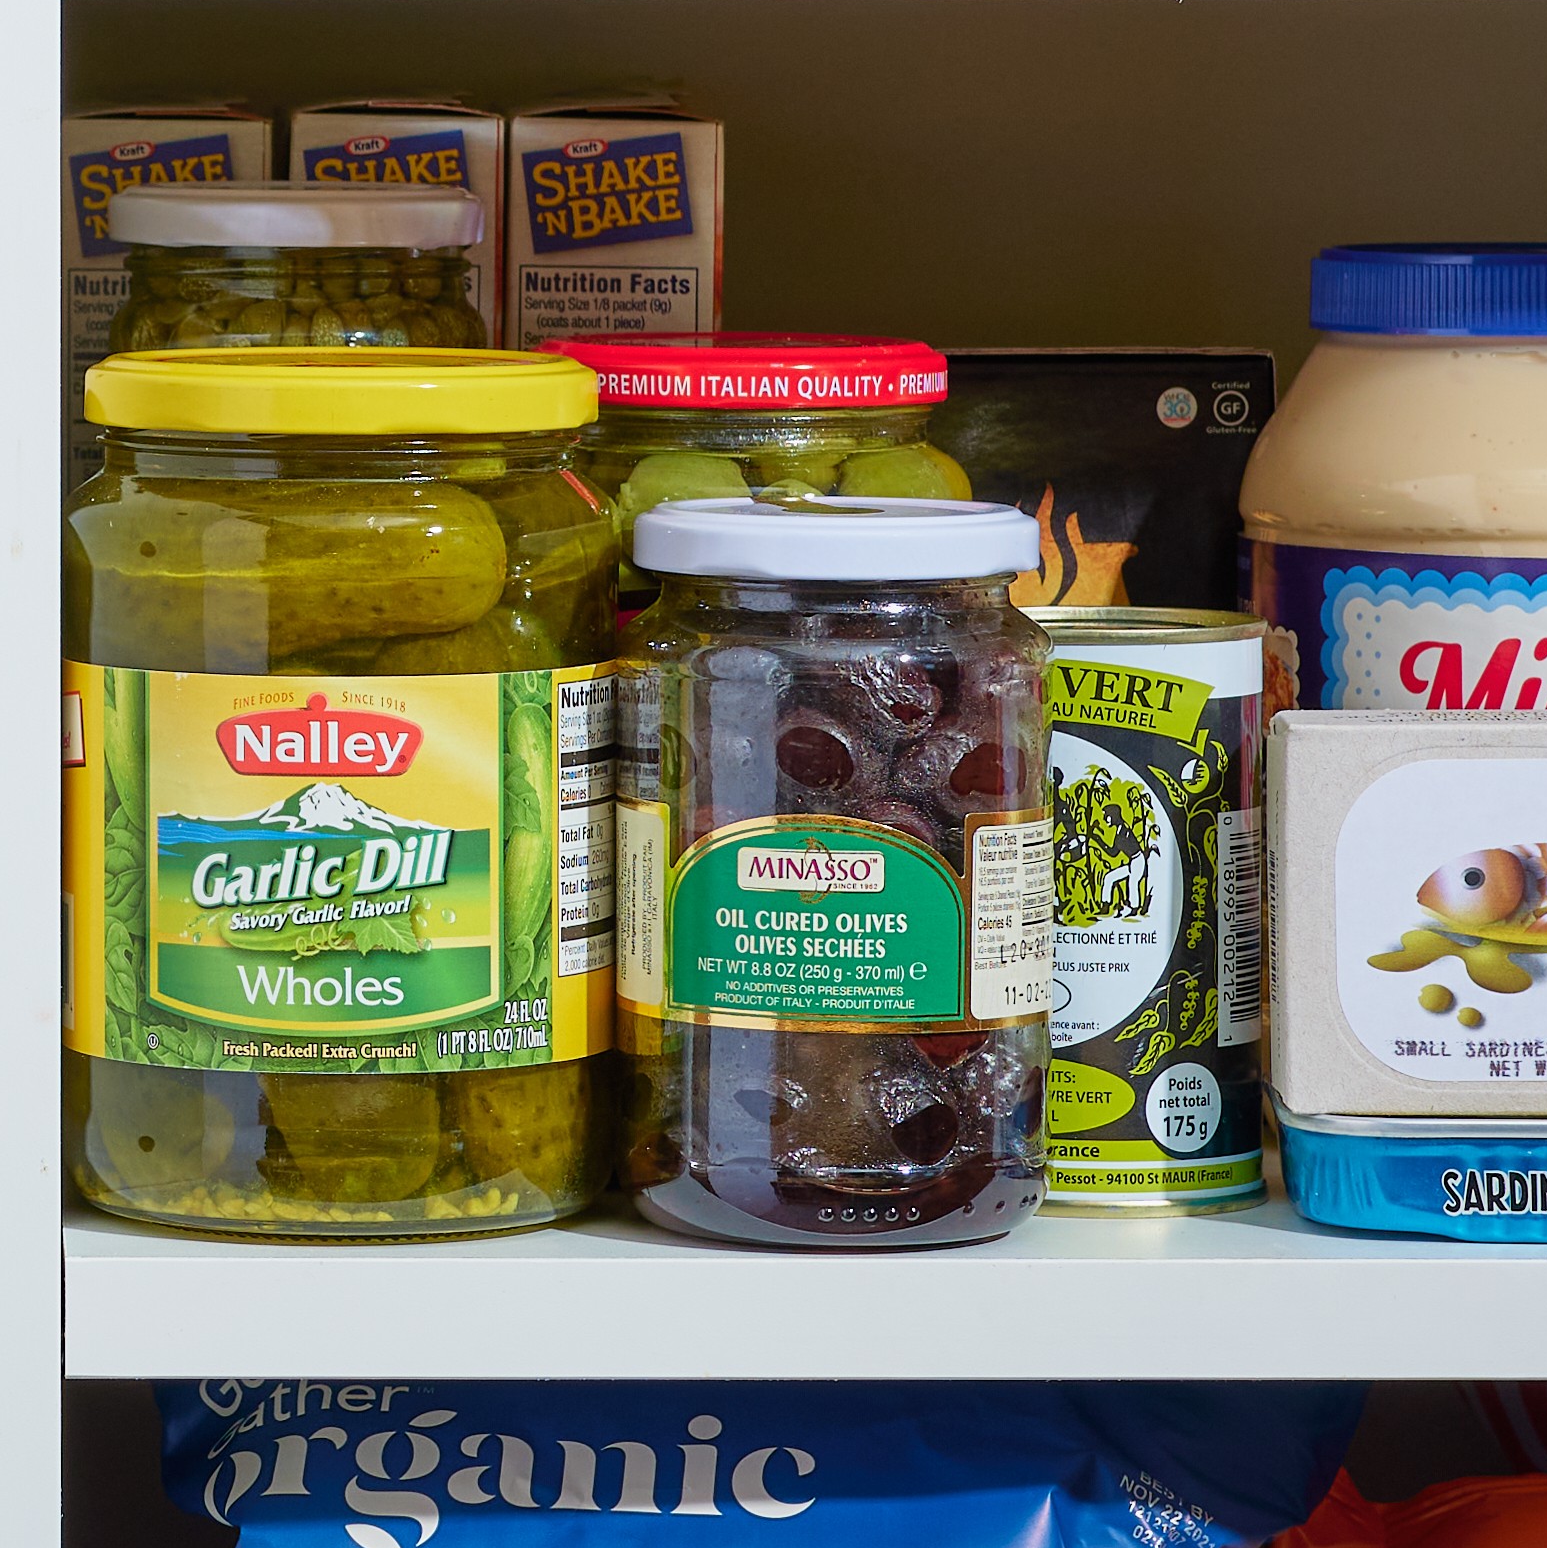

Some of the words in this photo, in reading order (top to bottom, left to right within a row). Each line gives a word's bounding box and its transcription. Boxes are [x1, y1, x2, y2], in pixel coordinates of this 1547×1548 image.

[535, 150, 680, 207] SHAKE
[524, 270, 624, 296] Nutrition
[630, 273, 691, 295] Facts
[597, 373, 692, 398] PREMIUM
[699, 376, 790, 397] ITALIAN
[797, 372, 882, 400] QUALITY
[1057, 666, 1184, 713] VERT
[233, 720, 409, 775] Nalley
[191, 844, 344, 909] Garlic
[354, 828, 455, 896] Dill
[748, 853, 871, 882] MINASSO
[716, 907, 749, 930] OIL
[754, 909, 831, 932] CURED
[836, 911, 908, 934] OLIVES
[735, 935, 798, 957] OLIVES
[803, 930, 886, 959] SECHÉES
[236, 964, 405, 1008] Wholes
[223, 1041, 259, 1058] Fresh
[262, 1042, 318, 1060] Packed!
[321, 1043, 358, 1059] Extra
[360, 1042, 417, 1059] Crunch!
[1168, 1076, 1202, 1092] Poids
[1159, 1093, 1183, 1108] net
[1185, 1091, 1210, 1108] total
